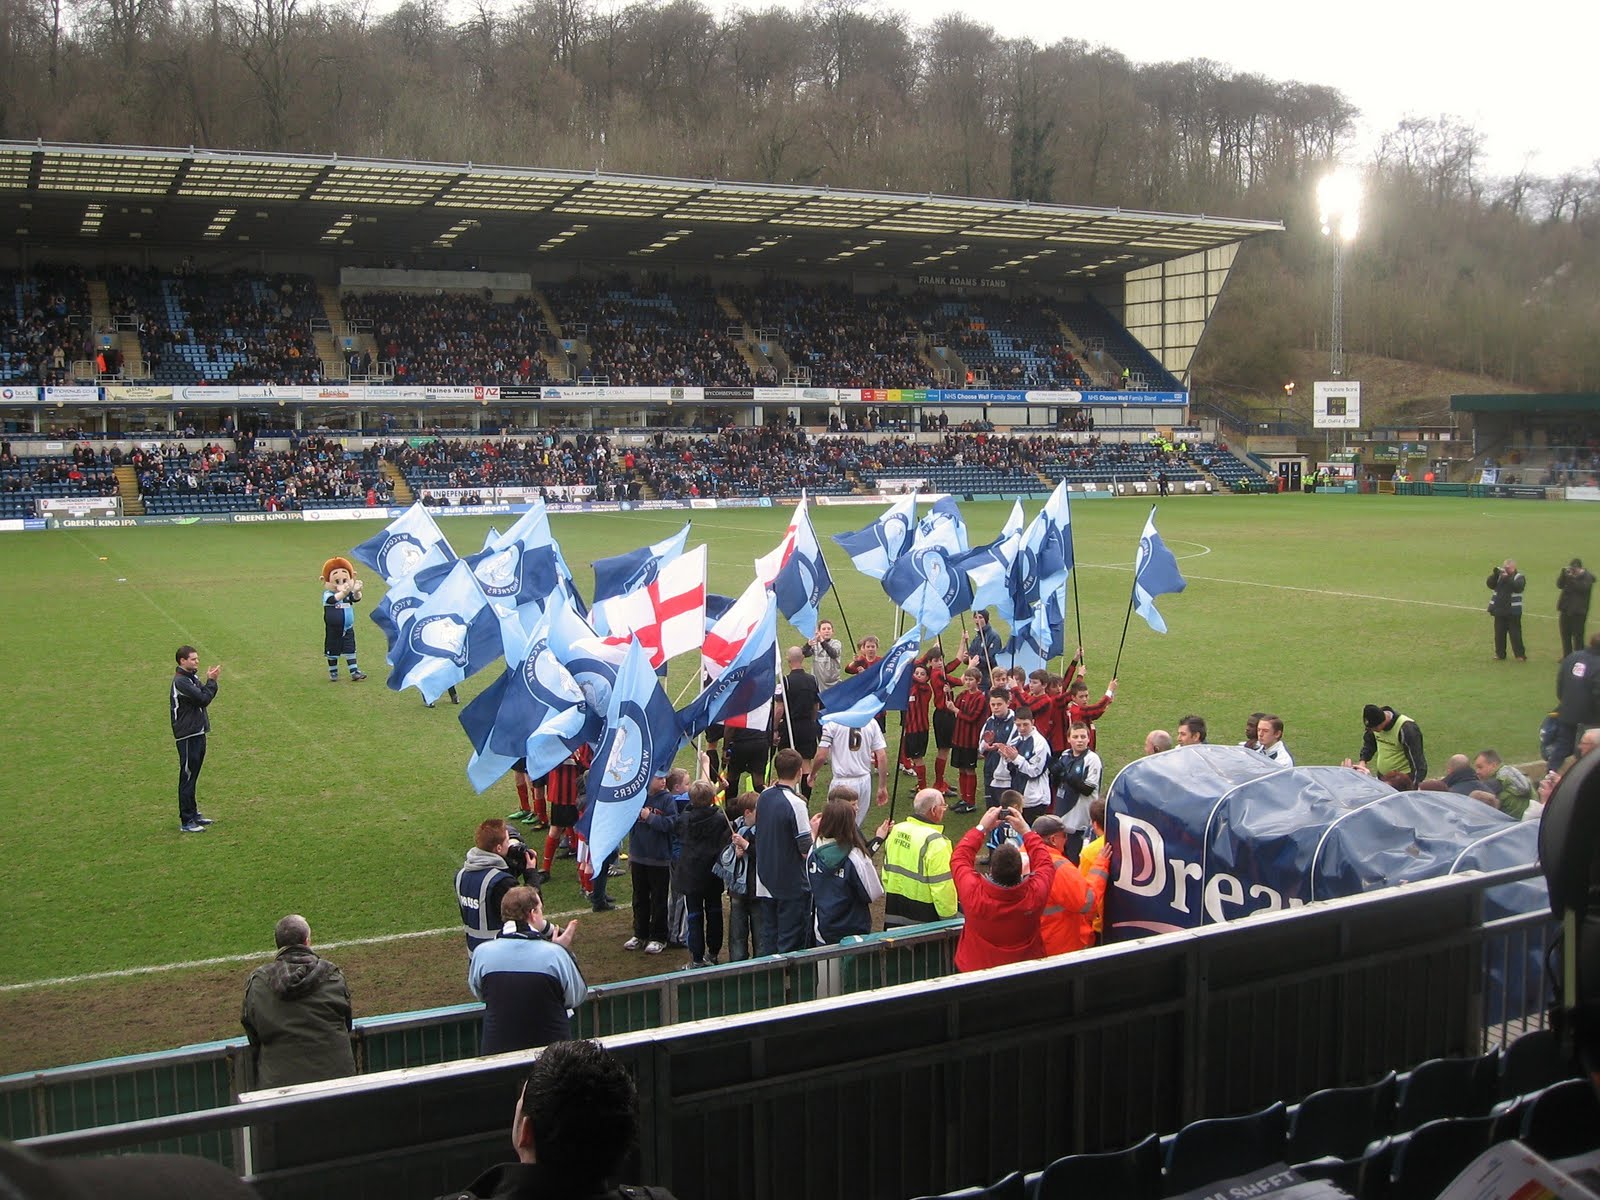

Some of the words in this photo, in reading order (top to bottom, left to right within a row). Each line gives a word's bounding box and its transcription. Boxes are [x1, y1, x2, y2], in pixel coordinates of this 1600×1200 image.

[918, 276, 946, 285] FRANK
[949, 278, 977, 287] ADAMS
[980, 279, 1006, 288] STAND
[466, 505, 510, 514] engineers
[234, 514, 265, 522] GREENE
[266, 513, 287, 521] KING
[287, 512, 303, 520] IPA
[98, 519, 120, 527] KING
[1113, 811, 1304, 921] Drea
[459, 895, 479, 909] PRESS
